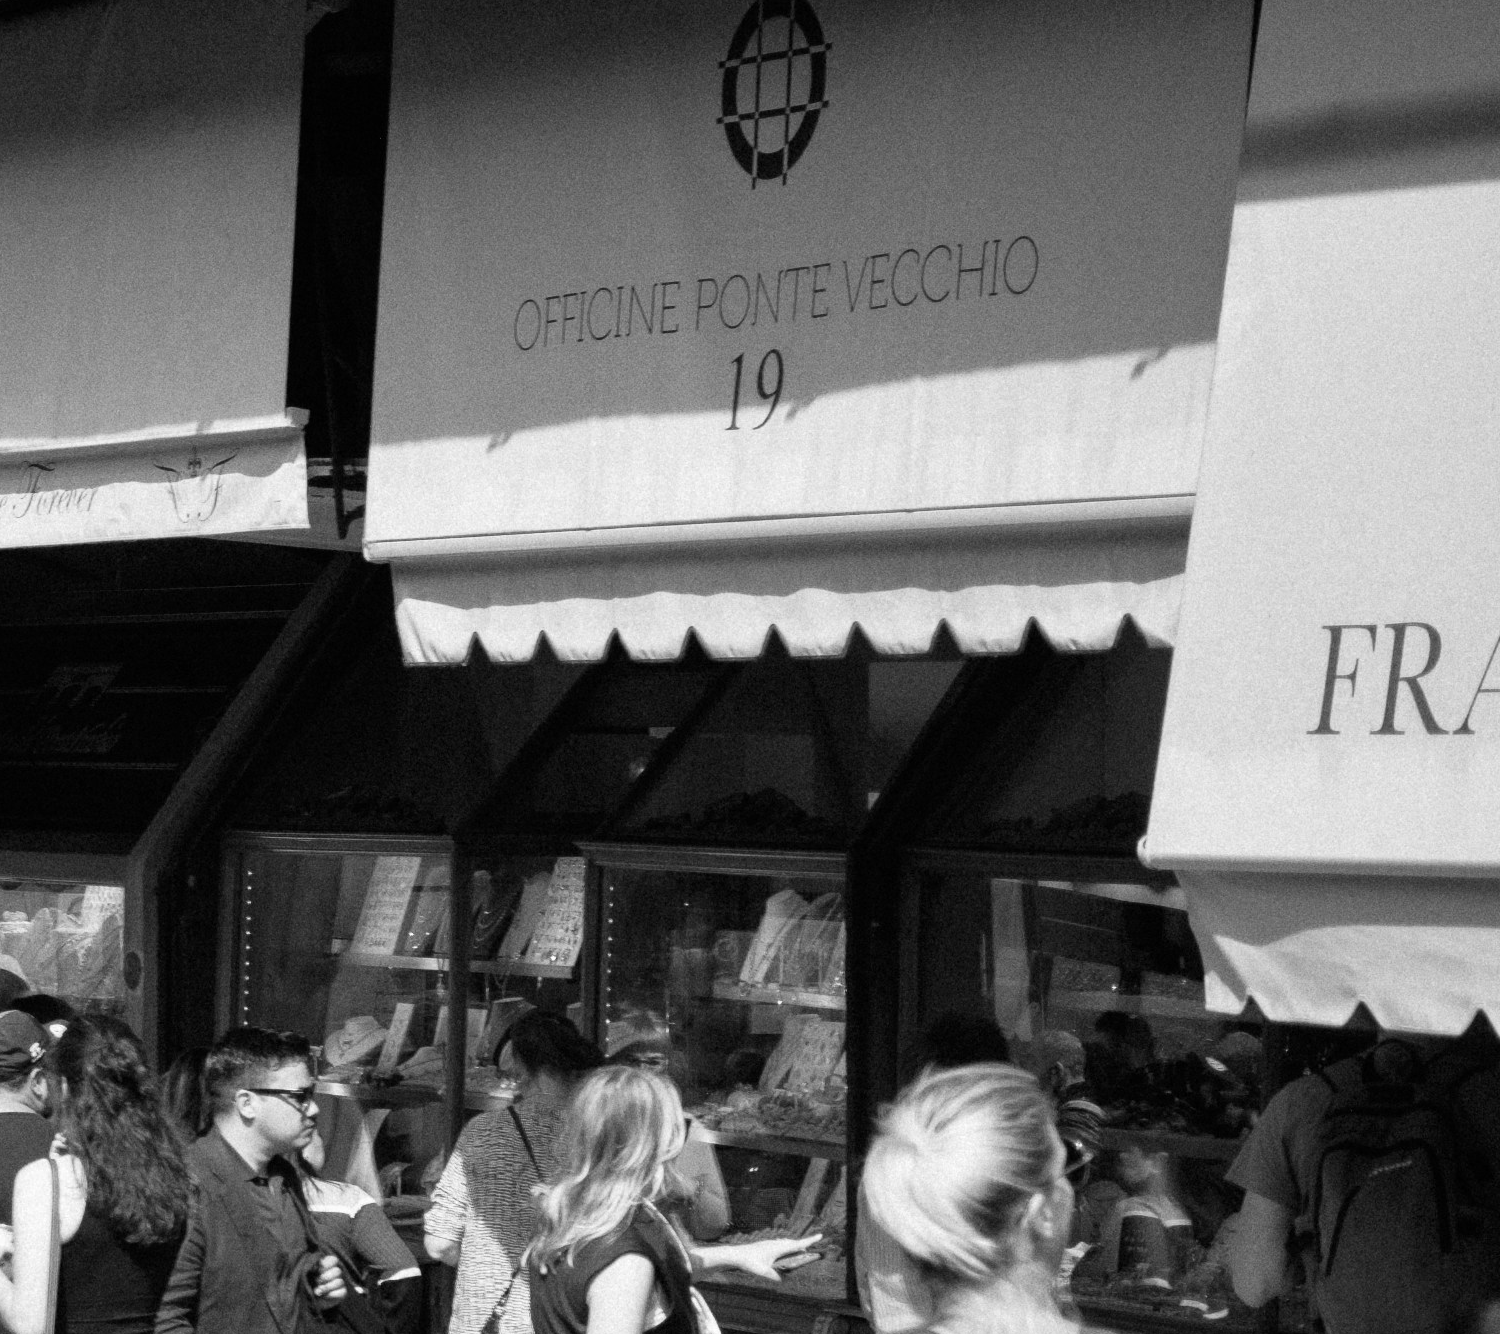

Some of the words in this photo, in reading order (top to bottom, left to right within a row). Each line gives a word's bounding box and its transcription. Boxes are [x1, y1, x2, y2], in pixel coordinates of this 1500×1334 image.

[514, 280, 681, 351] OFFICINE
[695, 262, 832, 330] PONTE
[843, 235, 1039, 313] VECCHIO
[725, 348, 785, 431] 19
[13, 460, 98, 519] Forever
